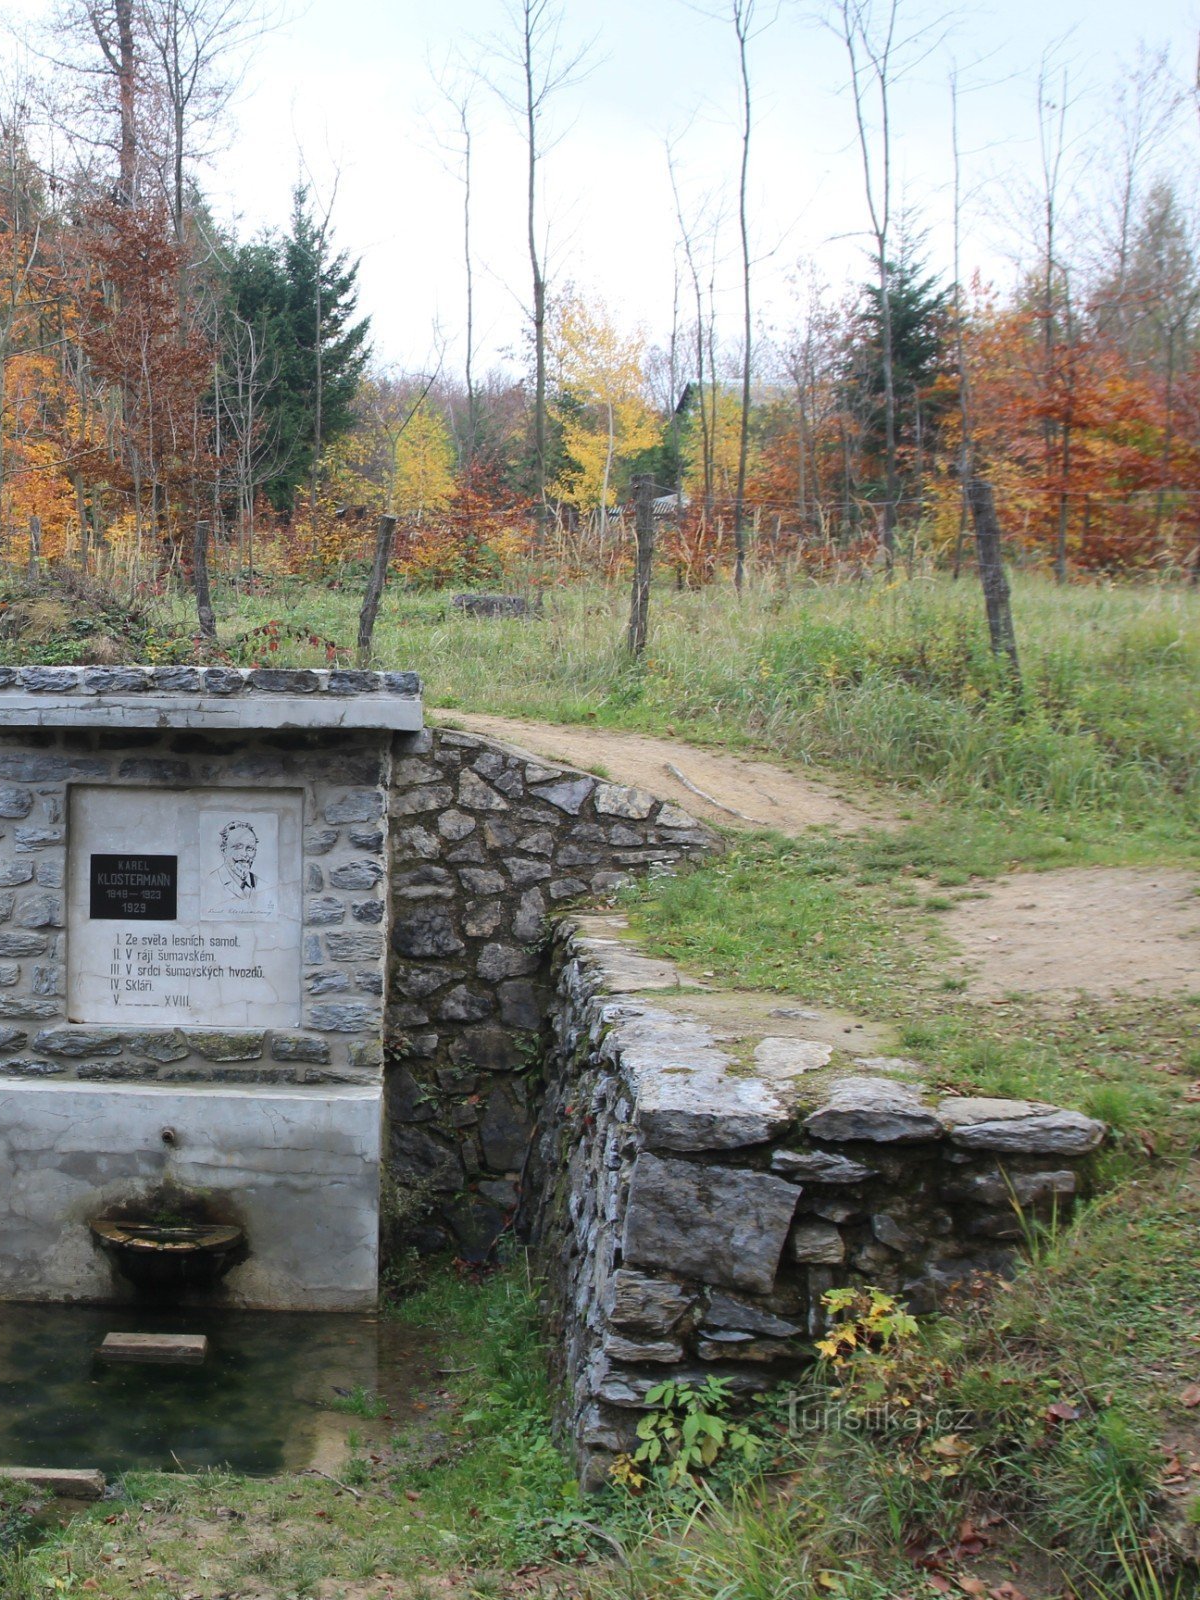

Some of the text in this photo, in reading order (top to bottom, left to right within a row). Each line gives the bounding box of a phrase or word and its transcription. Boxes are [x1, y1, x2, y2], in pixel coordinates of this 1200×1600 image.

[118, 861, 150, 871] KAREL
[121, 903, 146, 913] 1929
[126, 934, 138, 946] Ze
[142, 934, 167, 946] světa
[172, 934, 204, 947] lesních
[210, 936, 241, 948] samot.
[126, 949, 132, 960] V
[137, 950, 153, 963] ráji
[126, 964, 132, 976] V
[138, 965, 160, 976] srdci
[166, 965, 224, 980] šumavských
